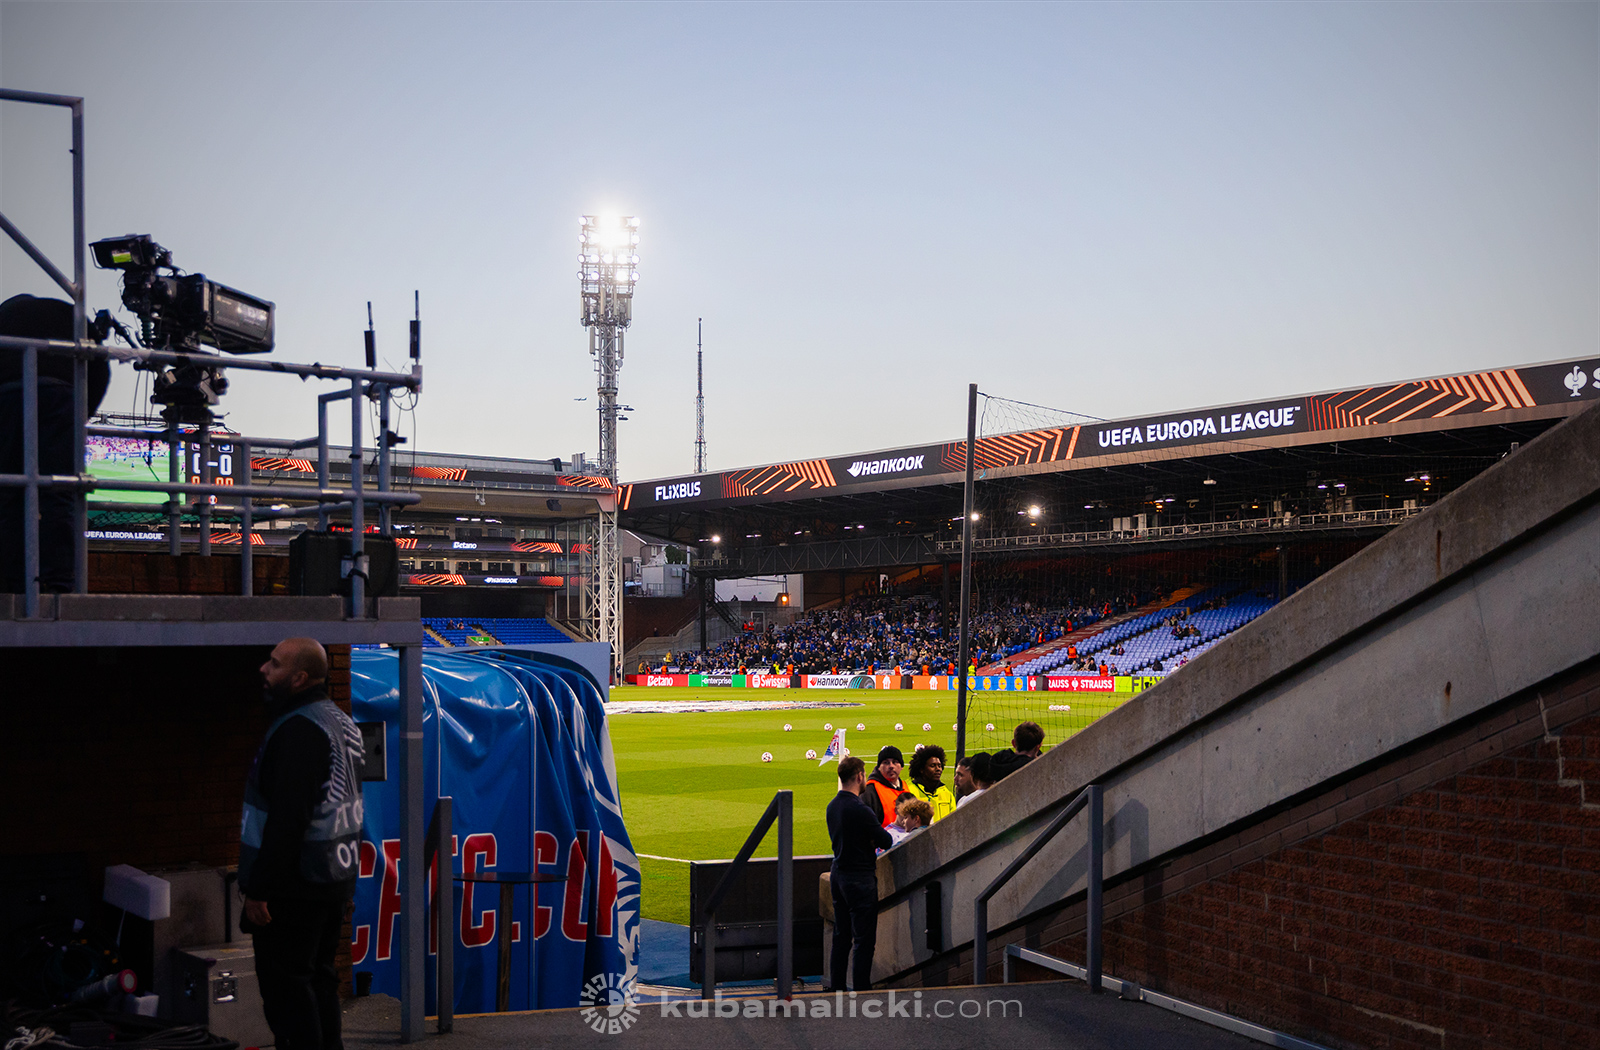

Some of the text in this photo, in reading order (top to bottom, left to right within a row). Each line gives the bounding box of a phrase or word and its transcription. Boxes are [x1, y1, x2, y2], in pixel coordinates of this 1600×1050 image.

[1099, 426, 1144, 448] UEFA
[1146, 417, 1217, 443] EUROPA
[84, 531, 104, 539] UEFA
[453, 541, 478, 549] Betano
[647, 675, 673, 686] Betano
[703, 677, 732, 685] enterprise
[1080, 679, 1112, 689] STRAUSS
